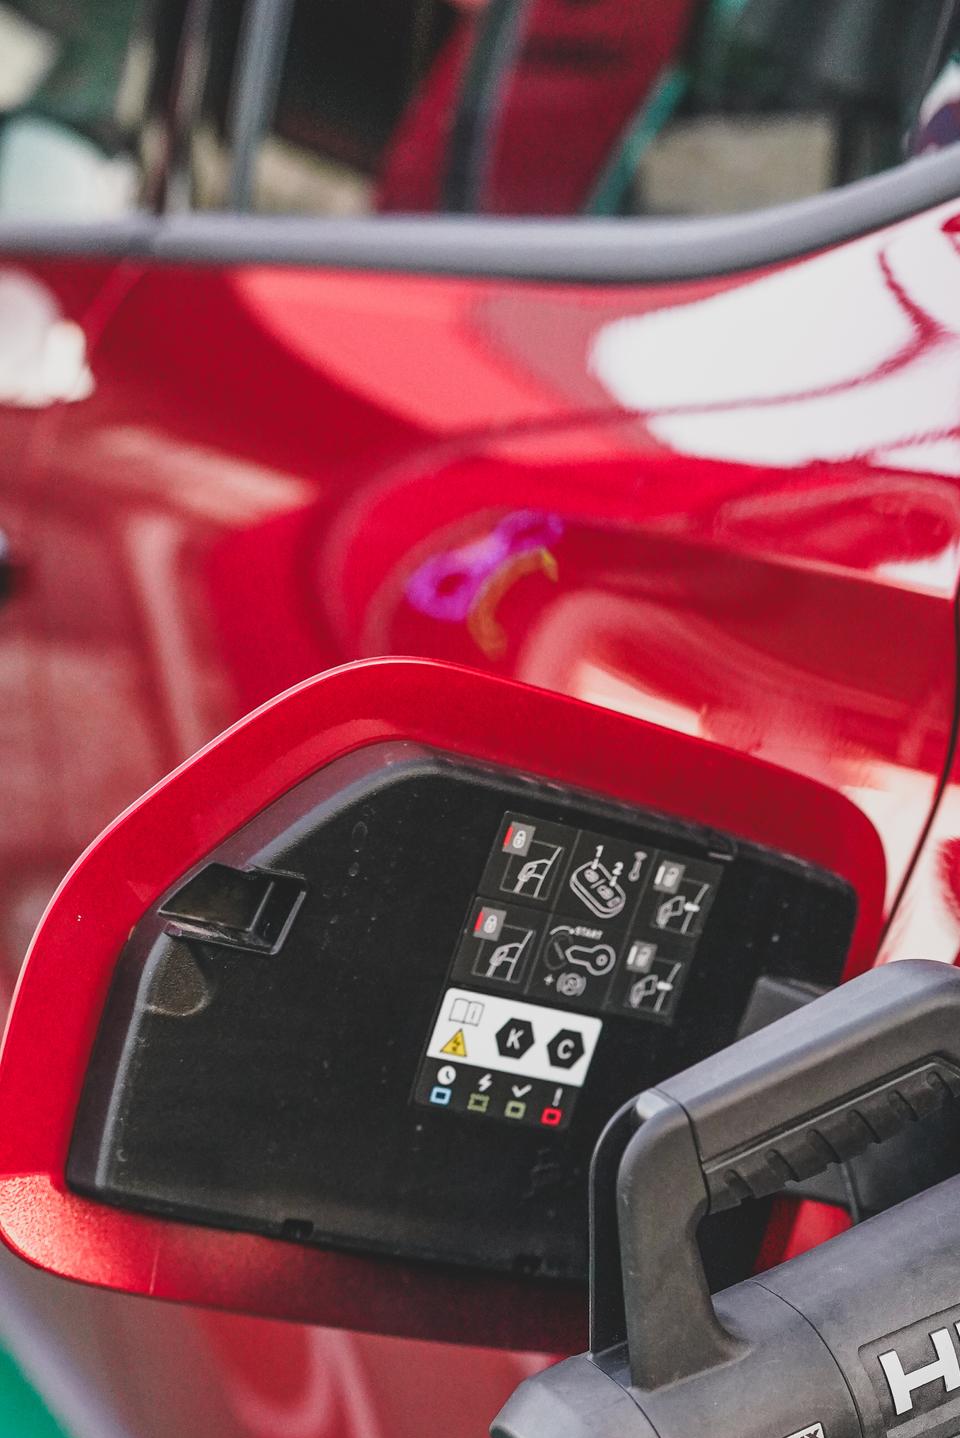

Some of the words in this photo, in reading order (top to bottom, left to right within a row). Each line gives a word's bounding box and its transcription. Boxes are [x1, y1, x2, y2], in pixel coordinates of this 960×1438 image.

[612, 861, 624, 877] 2
[506, 1028, 525, 1050] K
[556, 1038, 575, 1060] C
